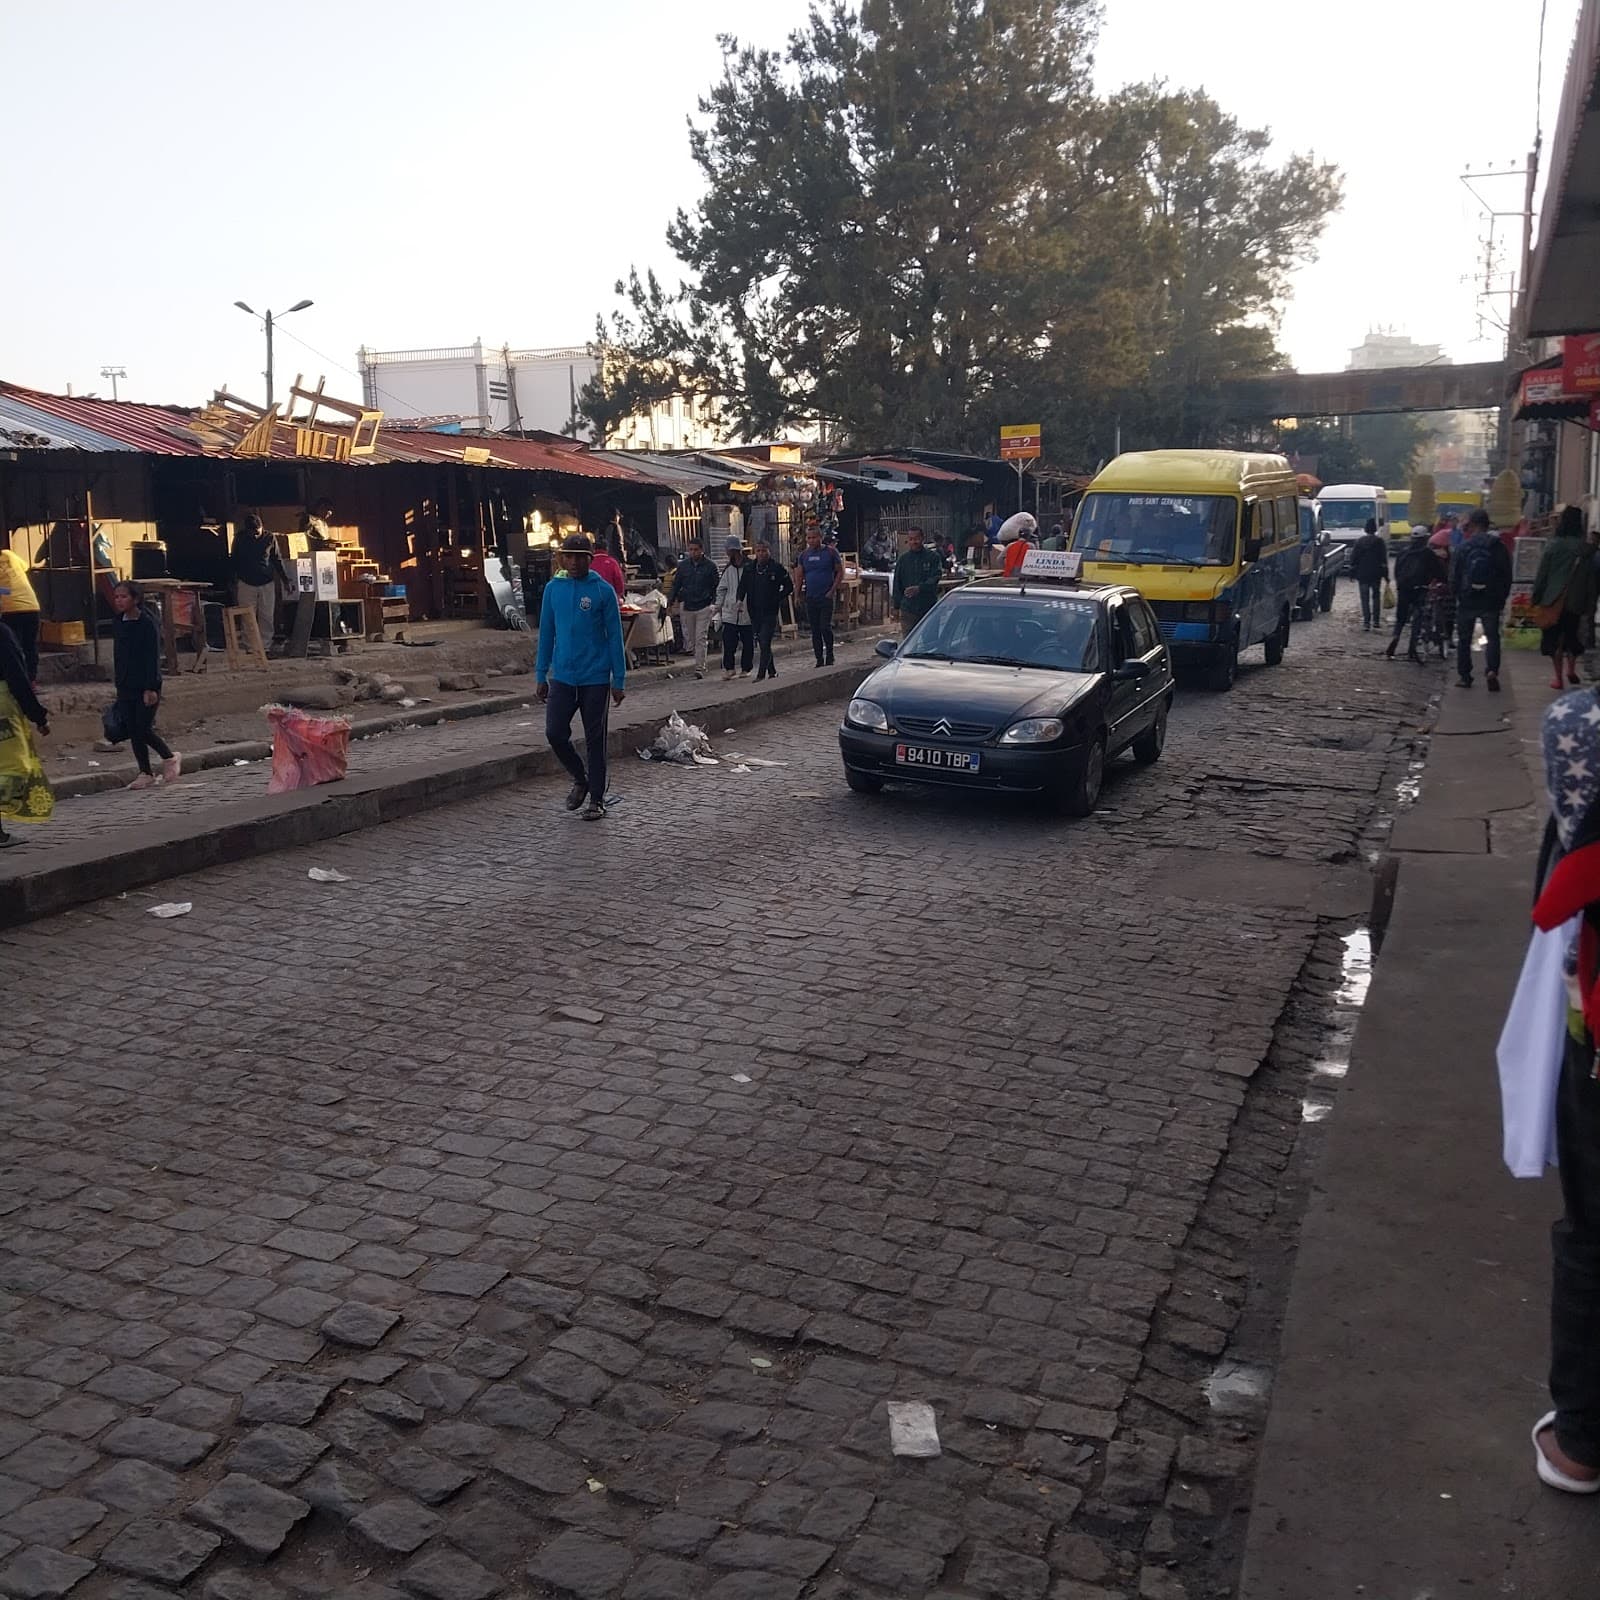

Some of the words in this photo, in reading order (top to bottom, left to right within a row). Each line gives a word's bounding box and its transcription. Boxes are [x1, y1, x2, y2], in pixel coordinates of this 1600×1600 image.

[1183, 498, 1193, 506] FC
[1035, 558, 1065, 566] LINDA
[908, 747, 941, 765] 9410
[946, 752, 971, 768] TBP
